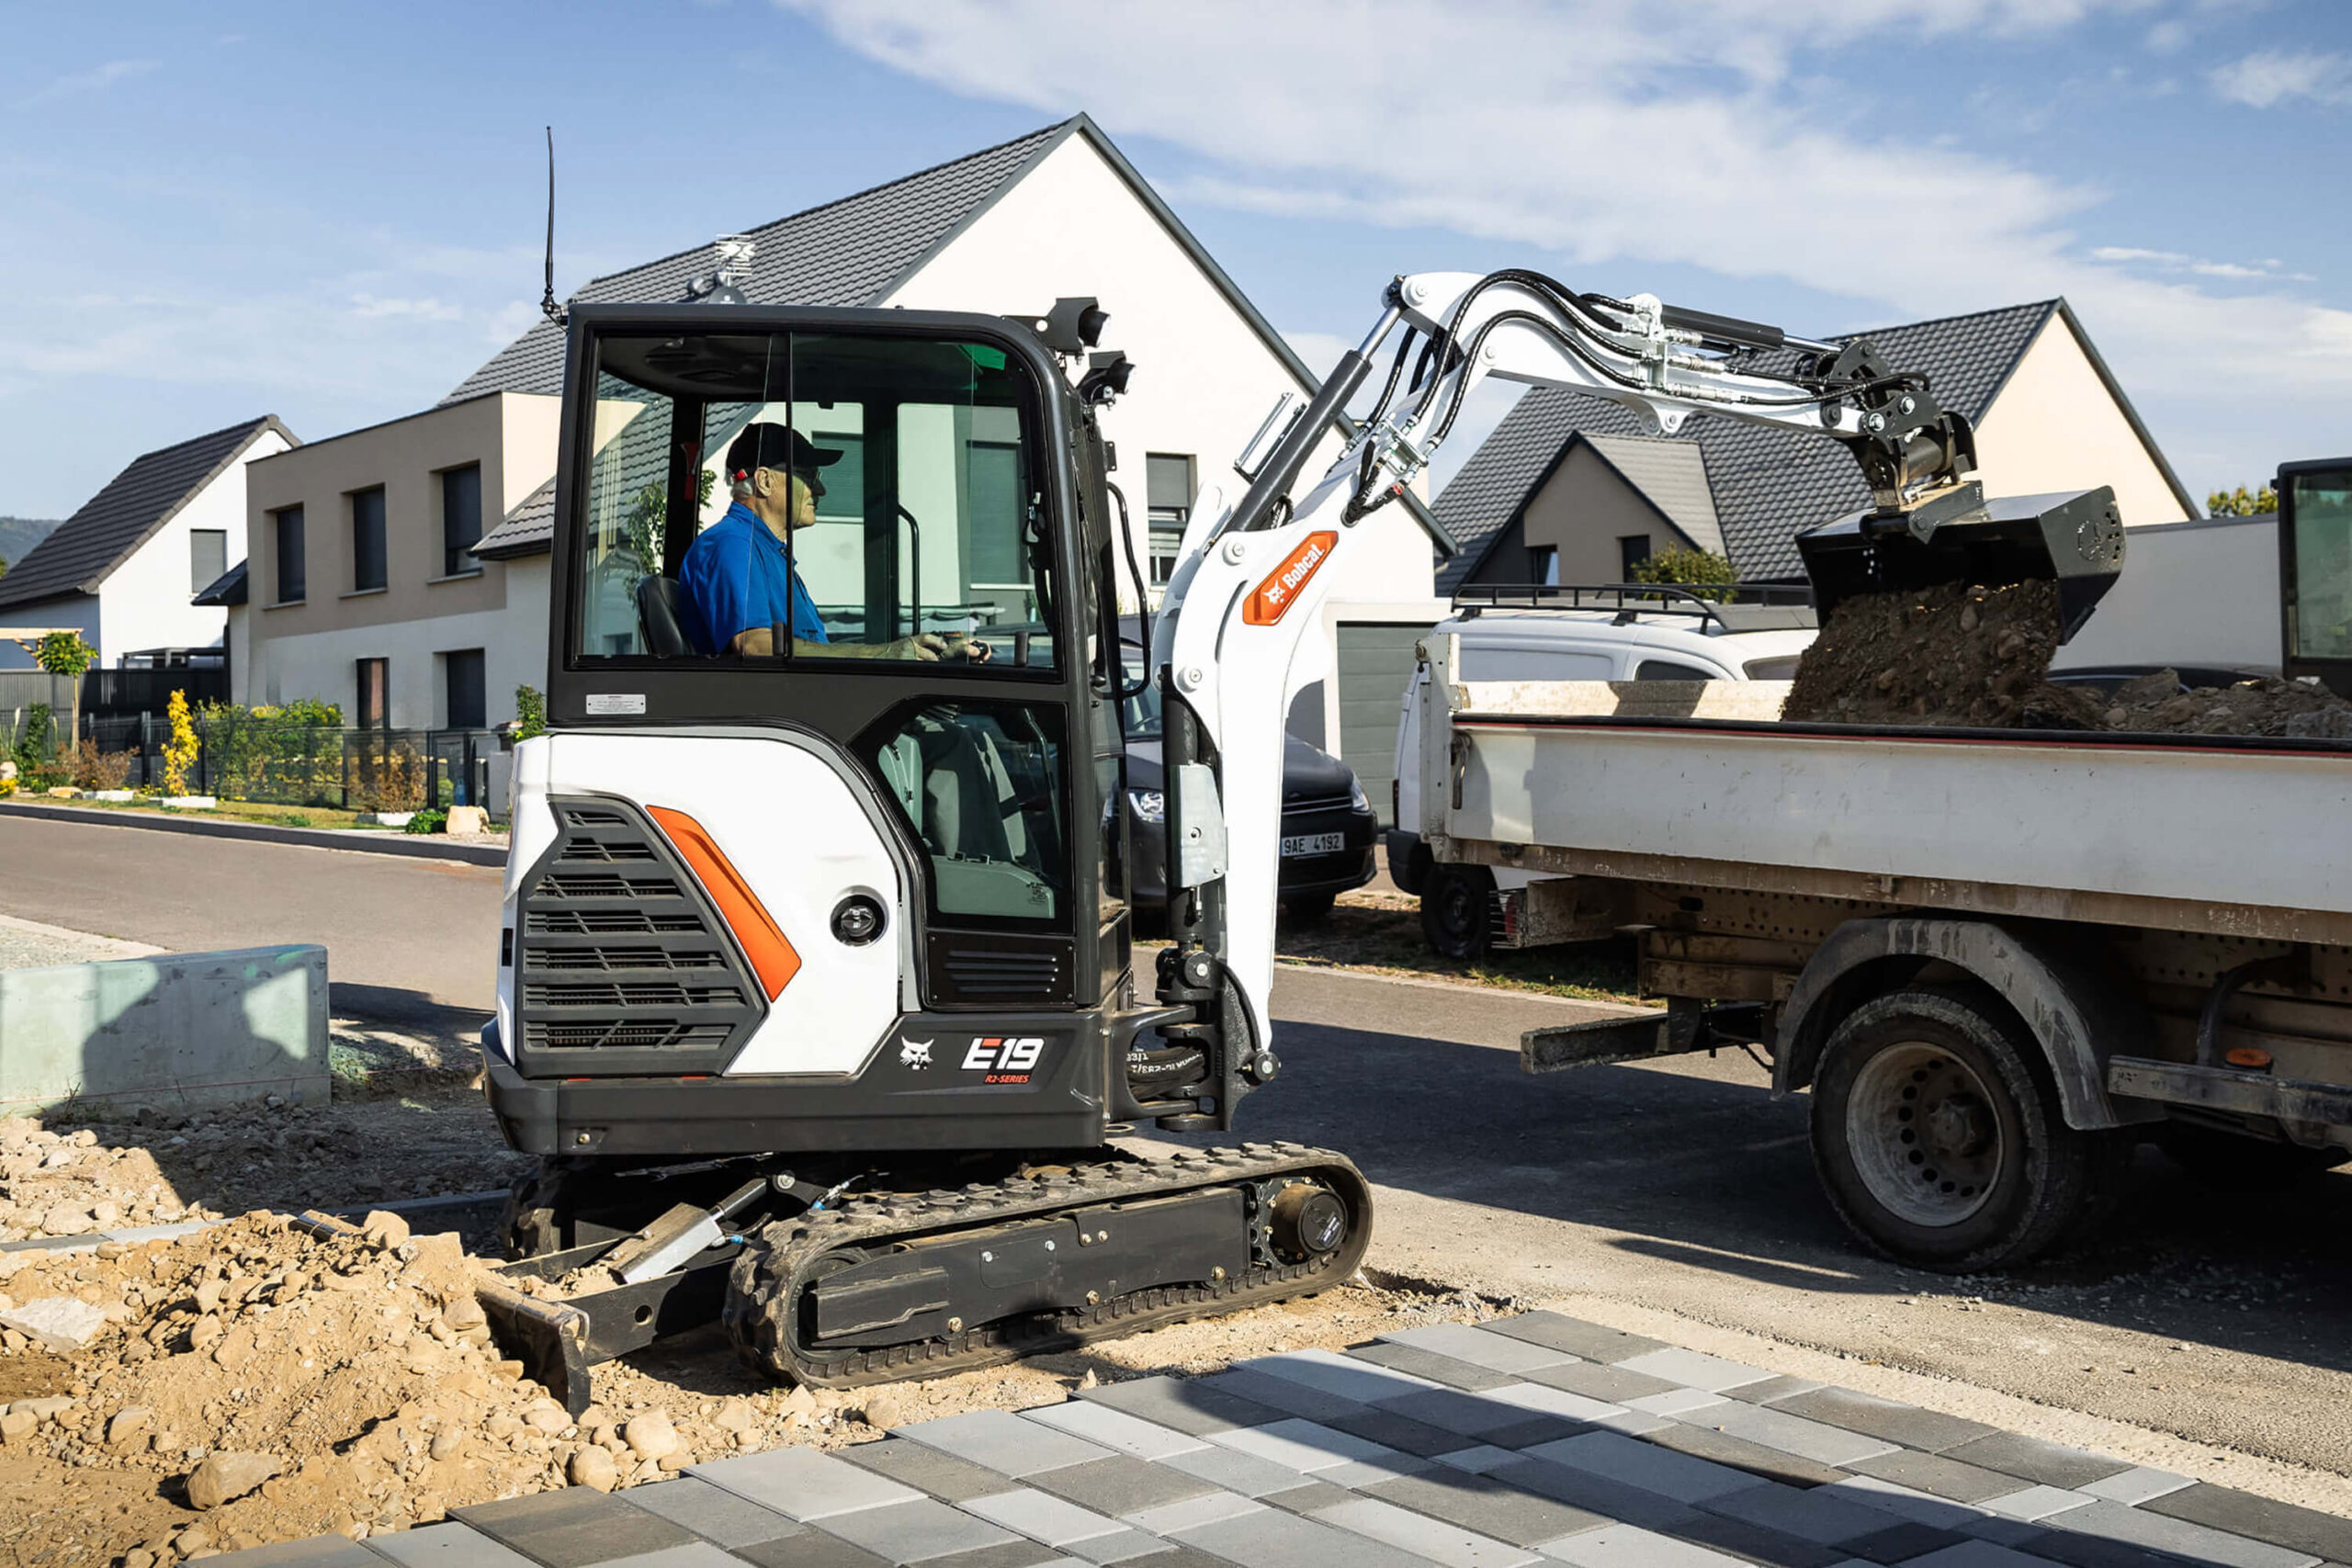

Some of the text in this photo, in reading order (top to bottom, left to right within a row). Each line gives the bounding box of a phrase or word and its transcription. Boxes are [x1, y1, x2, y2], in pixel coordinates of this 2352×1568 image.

[1282, 544, 1324, 590] Bobcat
[1284, 835, 1340, 853] 9AE 4192
[961, 1037, 1045, 1069] E19
[984, 1074, 1030, 1084] R2-SERIES
